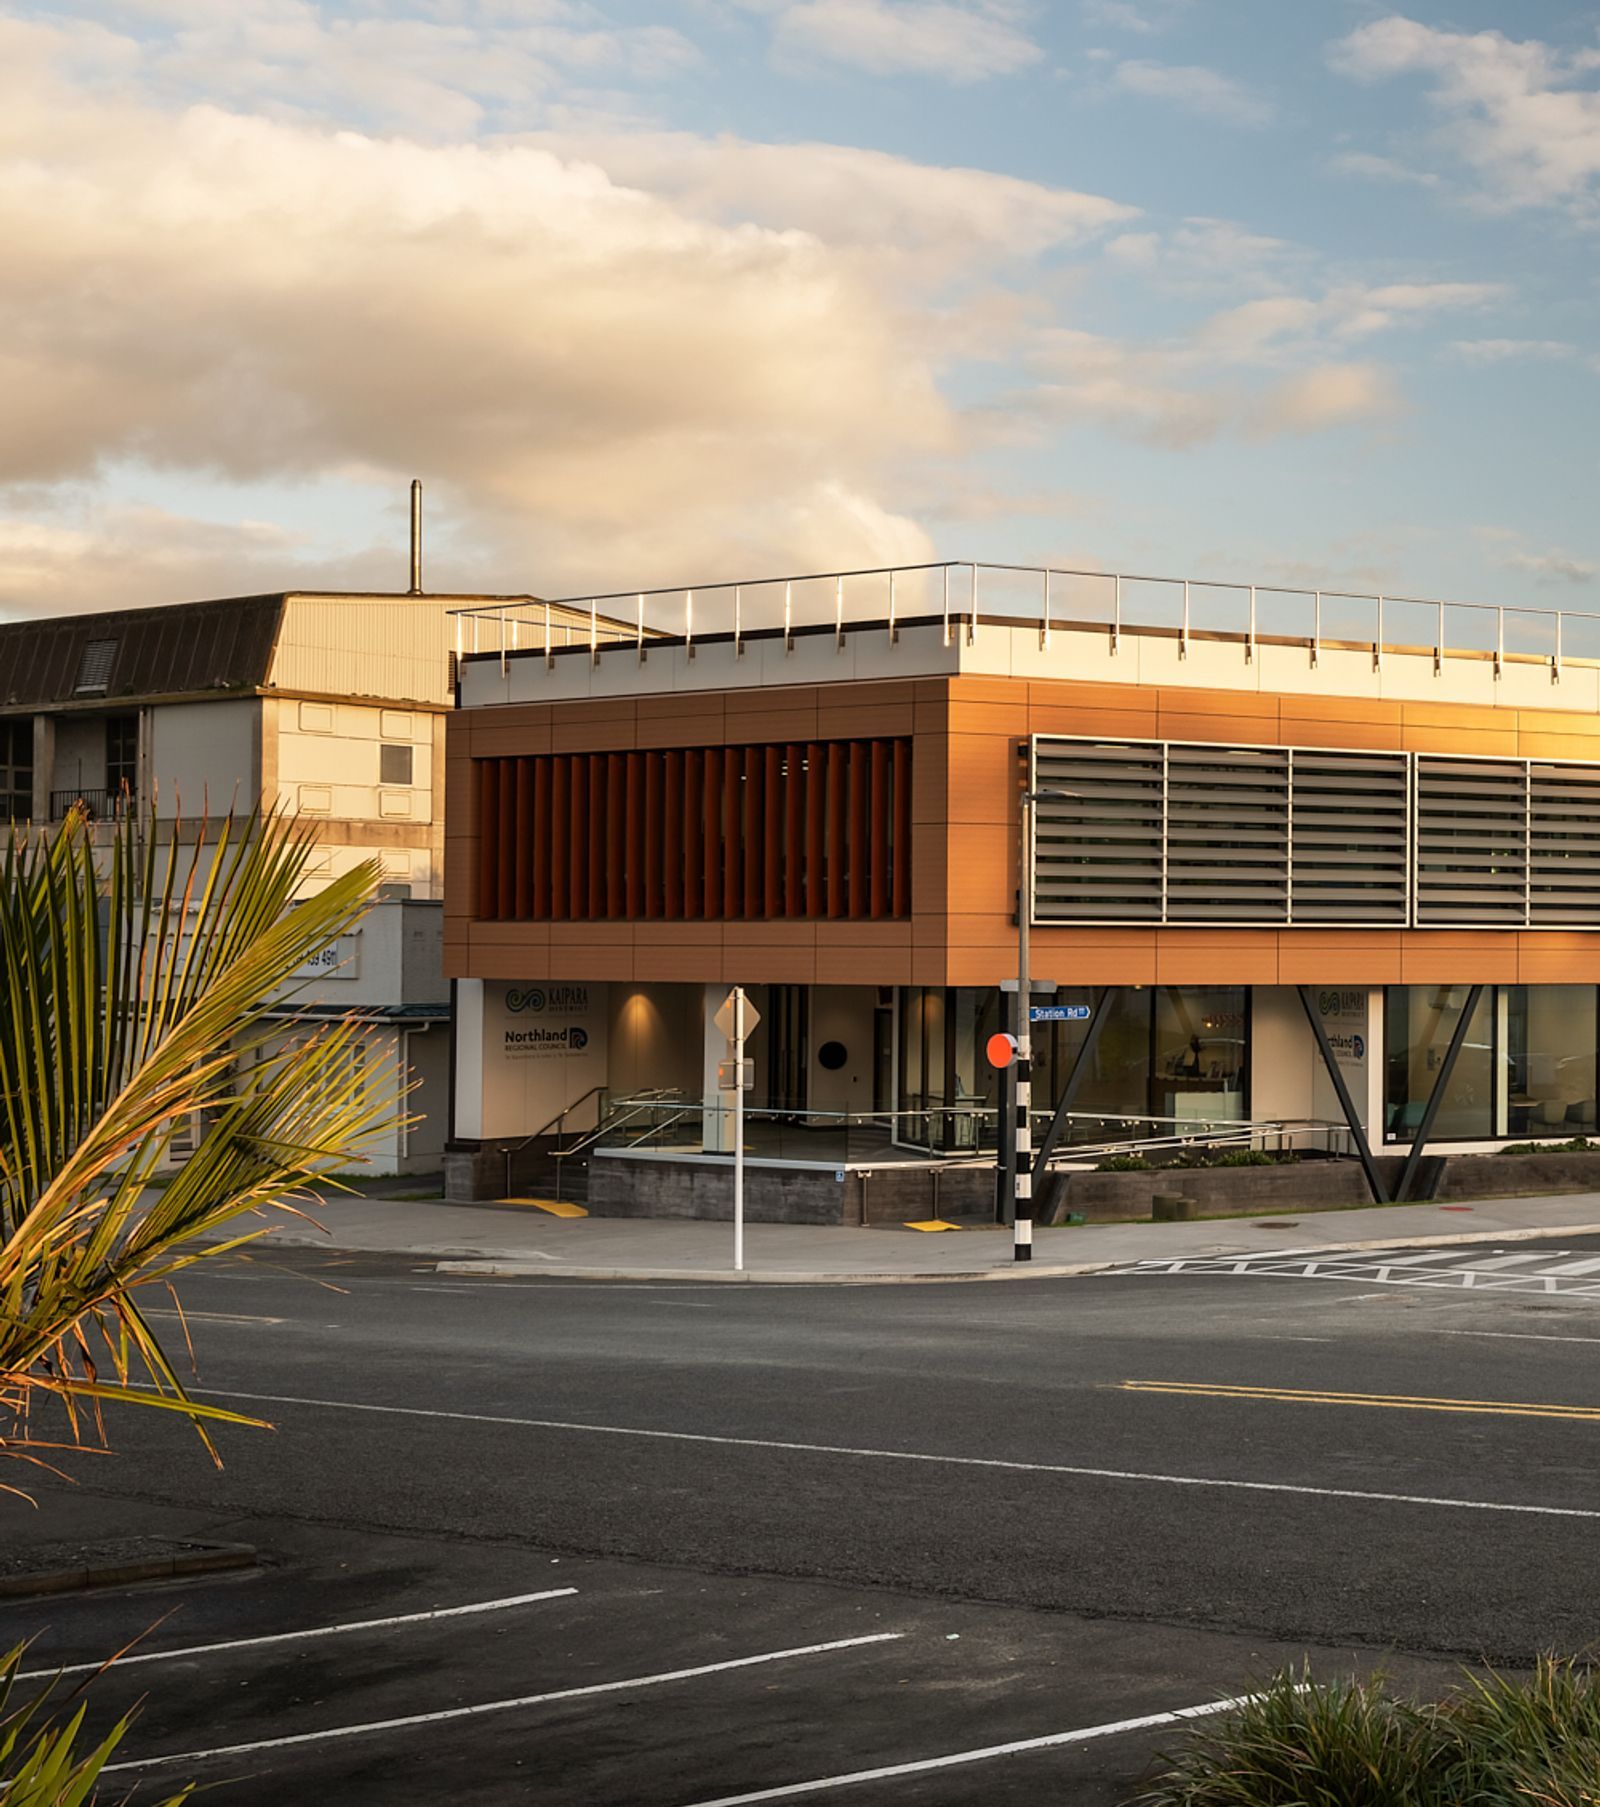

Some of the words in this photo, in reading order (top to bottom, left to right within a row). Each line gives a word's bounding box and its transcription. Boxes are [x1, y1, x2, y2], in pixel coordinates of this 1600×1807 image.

[548, 987, 588, 1004] KAIPARA
[1035, 1008, 1065, 1019] Station
[1067, 1007, 1078, 1018] Rd
[505, 1028, 568, 1042] Northland
[1327, 1033, 1352, 1048] rthland
[538, 1042, 567, 1050] COUNCIL
